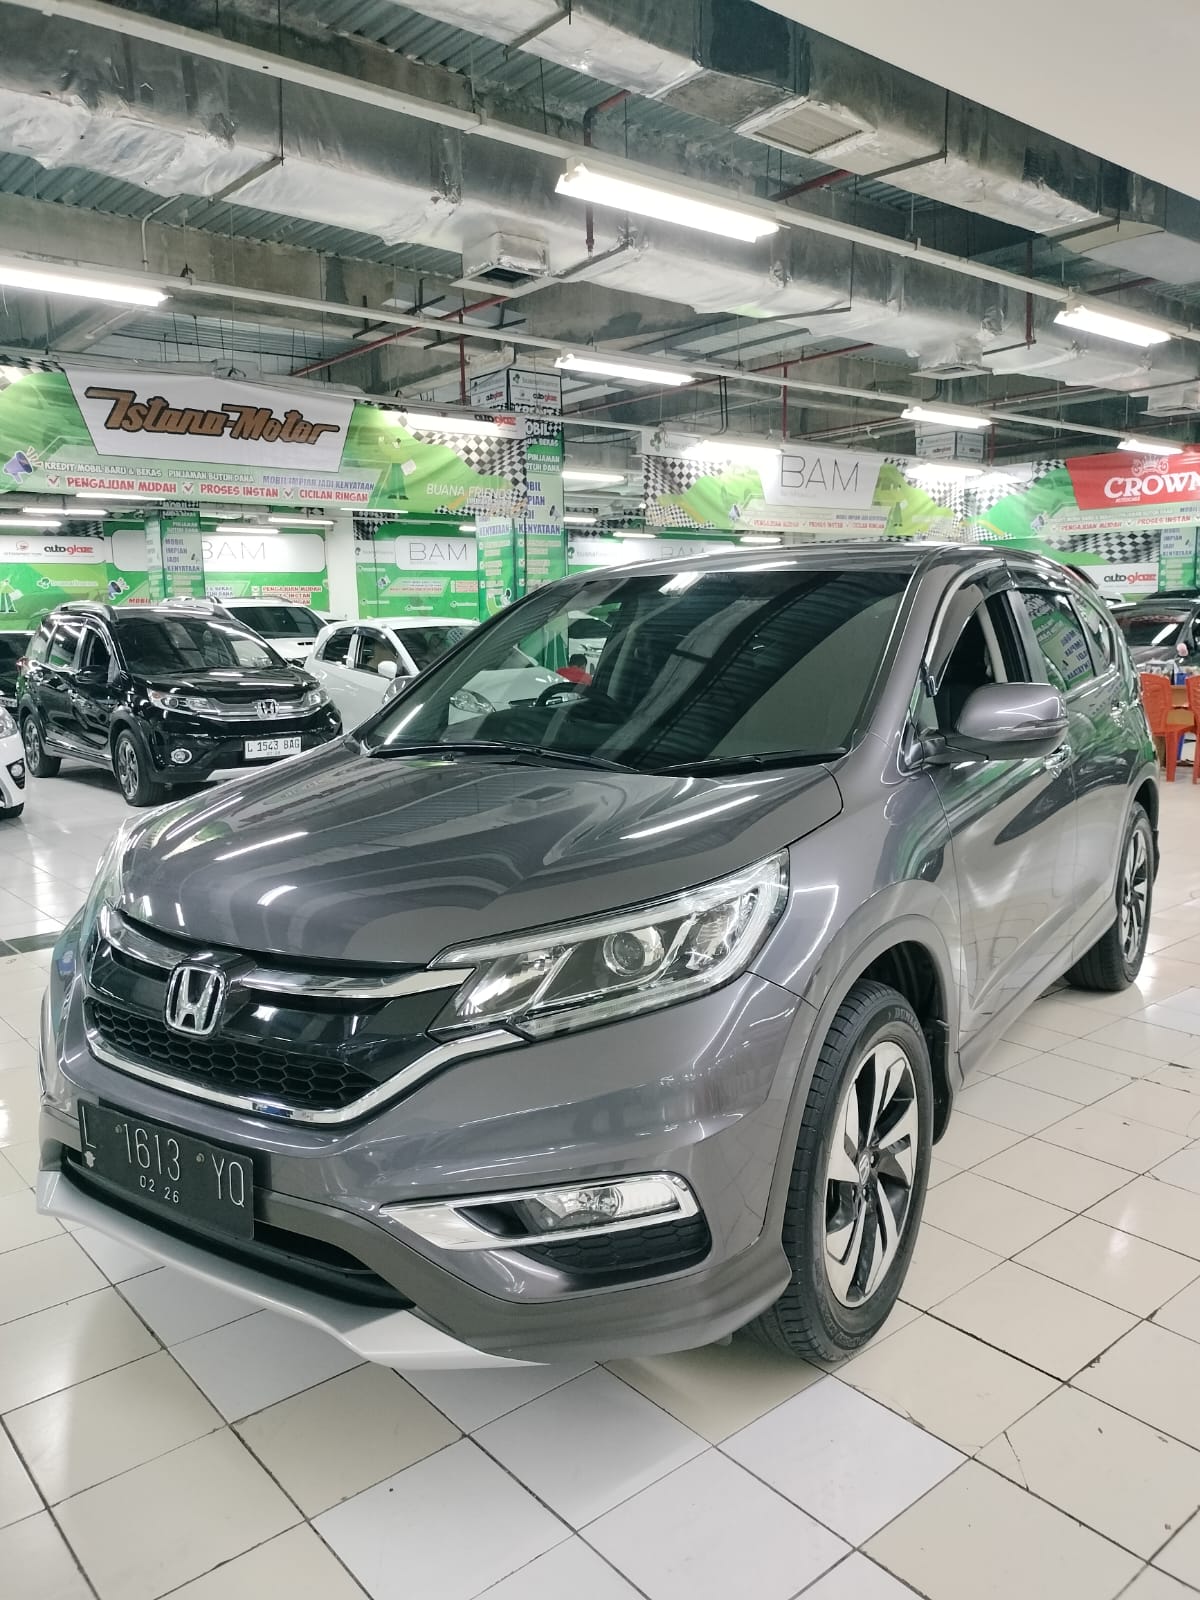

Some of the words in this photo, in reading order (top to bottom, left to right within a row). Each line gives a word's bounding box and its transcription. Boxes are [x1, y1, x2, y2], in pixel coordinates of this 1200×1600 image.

[526, 422, 550, 436] OBIL
[527, 454, 560, 462] PINJAMAN
[44, 462, 75, 471] KREDIT
[77, 464, 102, 473] MOBIL
[104, 465, 126, 474] BARU
[136, 468, 161, 478] BEKAS
[168, 470, 206, 480] PINJAMAN
[208, 472, 232, 481] BUTUH
[234, 474, 254, 482] DANA
[263, 476, 286, 485] MOBIL
[318, 479, 334, 488] JADI
[336, 480, 374, 490] KENYATAAN
[780, 454, 859, 492] BAM
[66, 477, 134, 490] PENGAJUAN
[138, 480, 176, 492] MUDAH
[200, 484, 240, 494] PROSES
[242, 486, 278, 498] INSTAN
[300, 490, 332, 500] CICILAN
[336, 492, 368, 502] RINGAN
[426, 483, 464, 496] BUANA
[527, 496, 545, 506] PIAN
[518, 524, 560, 534] KENYATAAN
[202, 540, 266, 560] BAM
[410, 542, 468, 560] BAM
[248, 742, 252, 752] L
[284, 739, 300, 749] BAG
[82, 1106, 97, 1148] L
[124, 1123, 180, 1181] 1613
[211, 1153, 245, 1208] YQ
[140, 1175, 155, 1192] 02
[164, 1186, 180, 1203] 26
